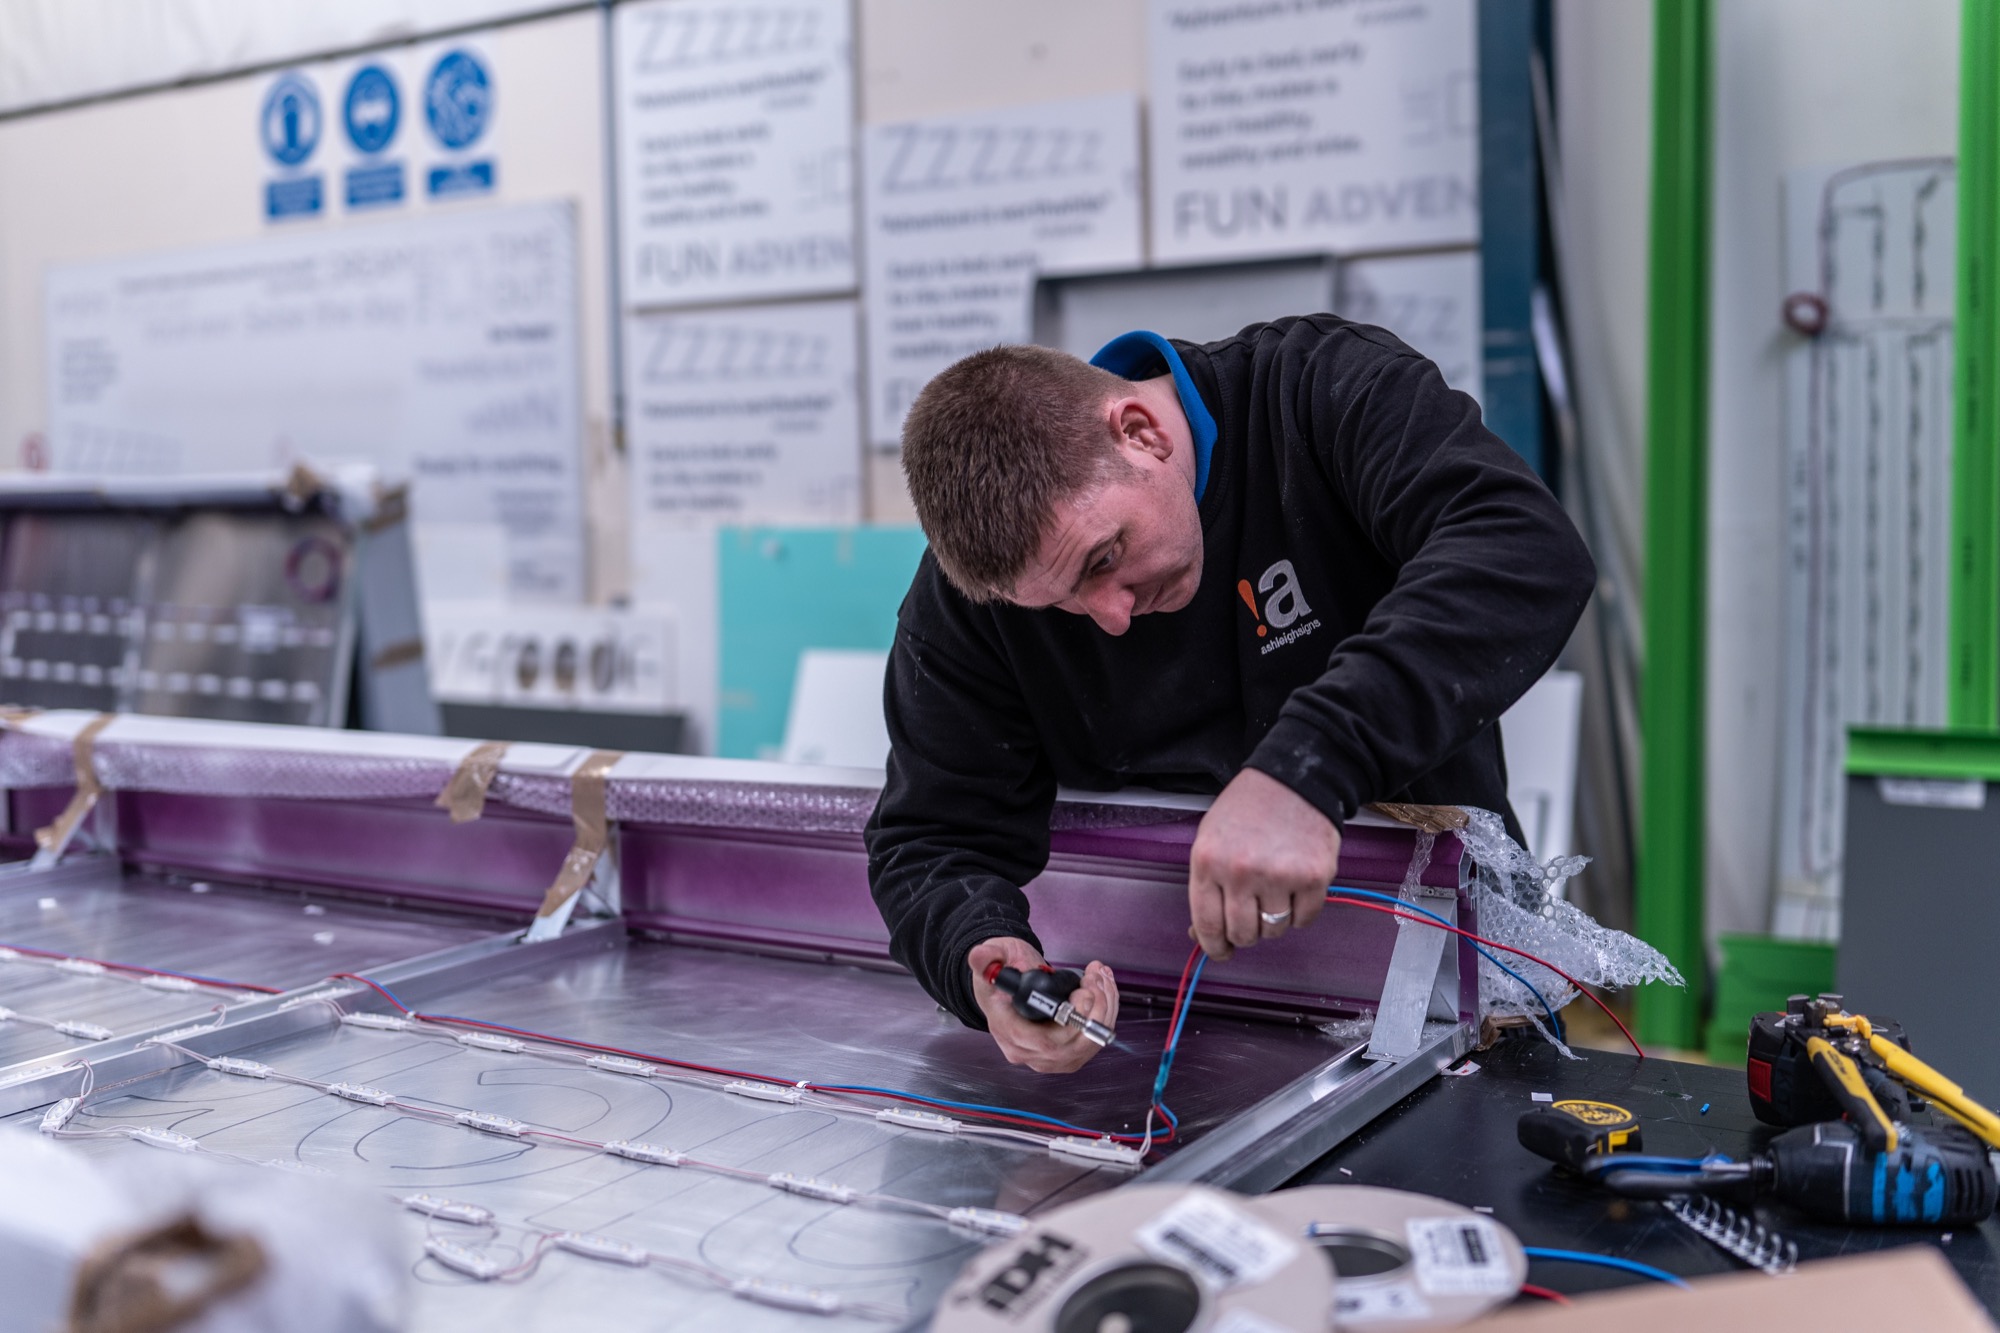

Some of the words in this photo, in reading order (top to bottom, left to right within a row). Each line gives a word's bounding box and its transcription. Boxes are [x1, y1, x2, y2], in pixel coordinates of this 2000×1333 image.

[1176, 188, 1285, 238] FUN
[639, 243, 717, 282] FUN
[1260, 618, 1321, 655] ashleighsigns
